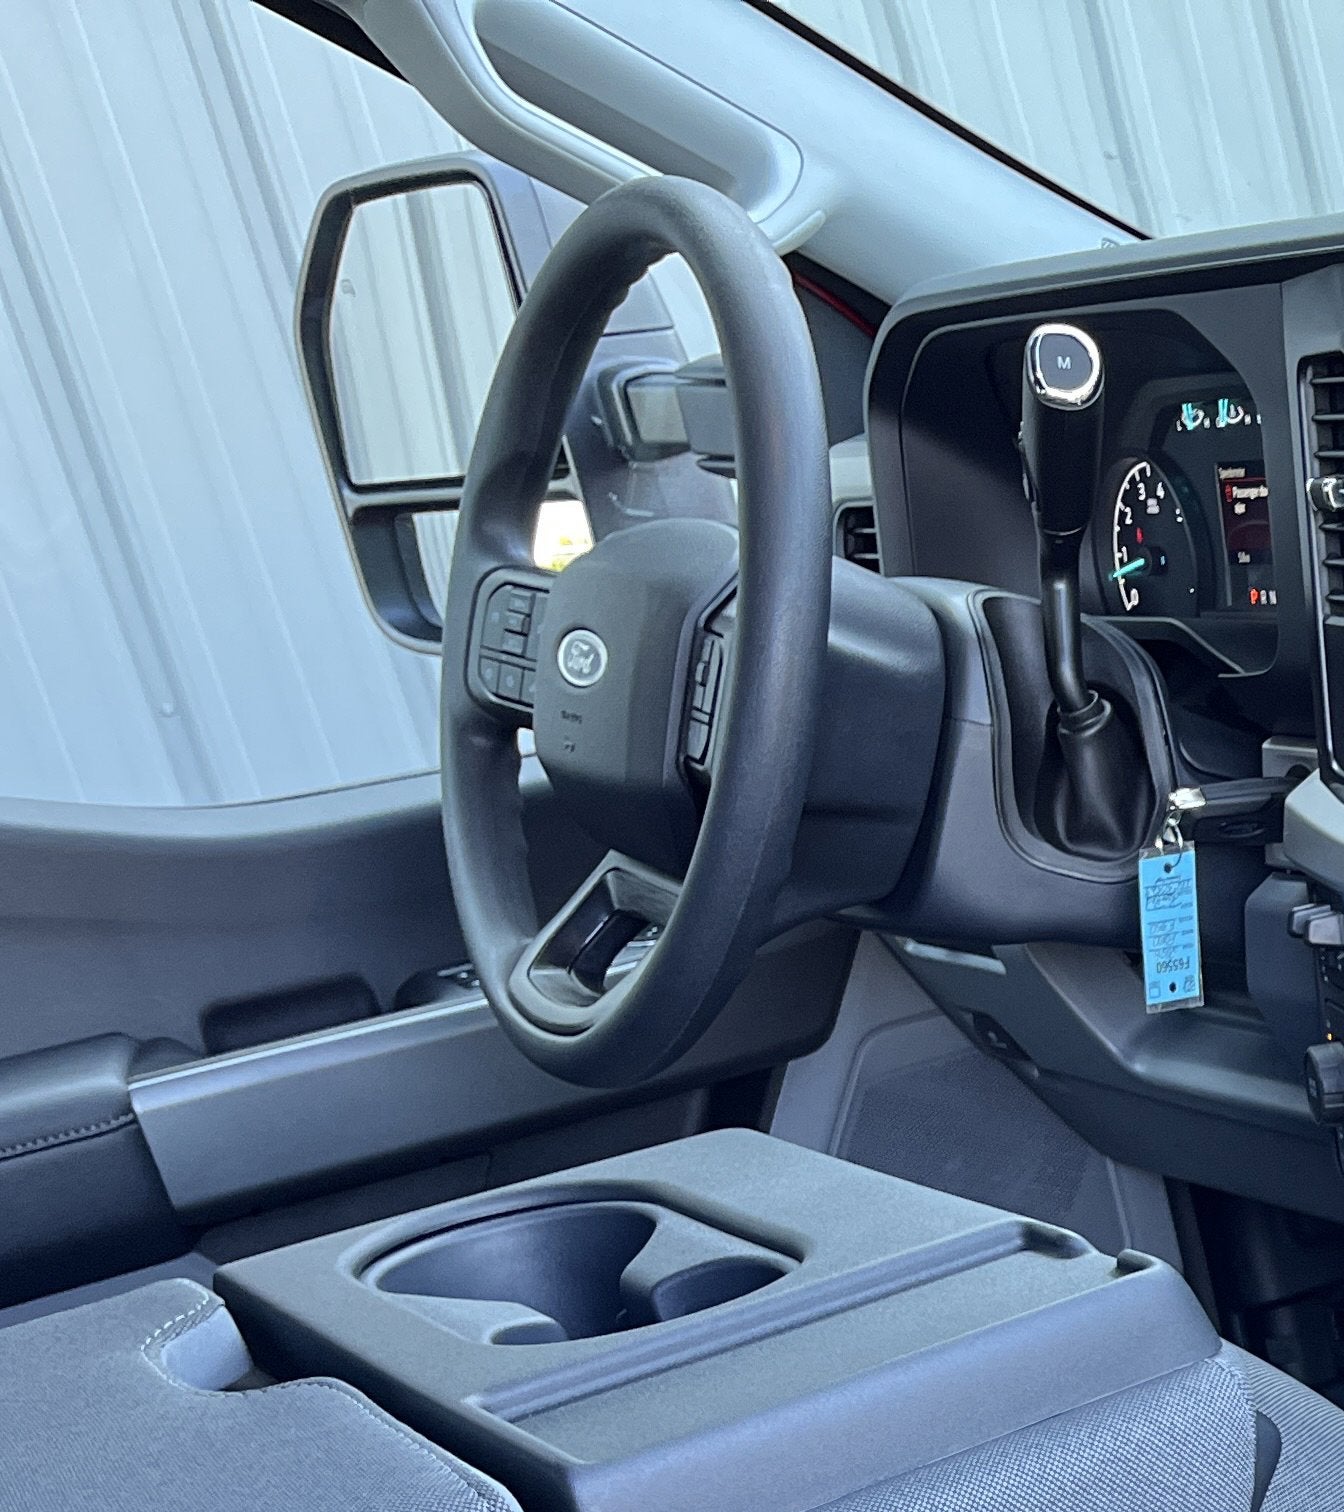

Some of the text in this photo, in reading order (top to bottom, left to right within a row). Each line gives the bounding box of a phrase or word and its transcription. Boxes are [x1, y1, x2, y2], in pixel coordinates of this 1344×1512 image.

[1057, 355, 1072, 370] M
[1137, 482, 1146, 500] 3
[1156, 481, 1165, 499] 4
[1125, 507, 1133, 525] 2
[1121, 546, 1128, 563] 1
